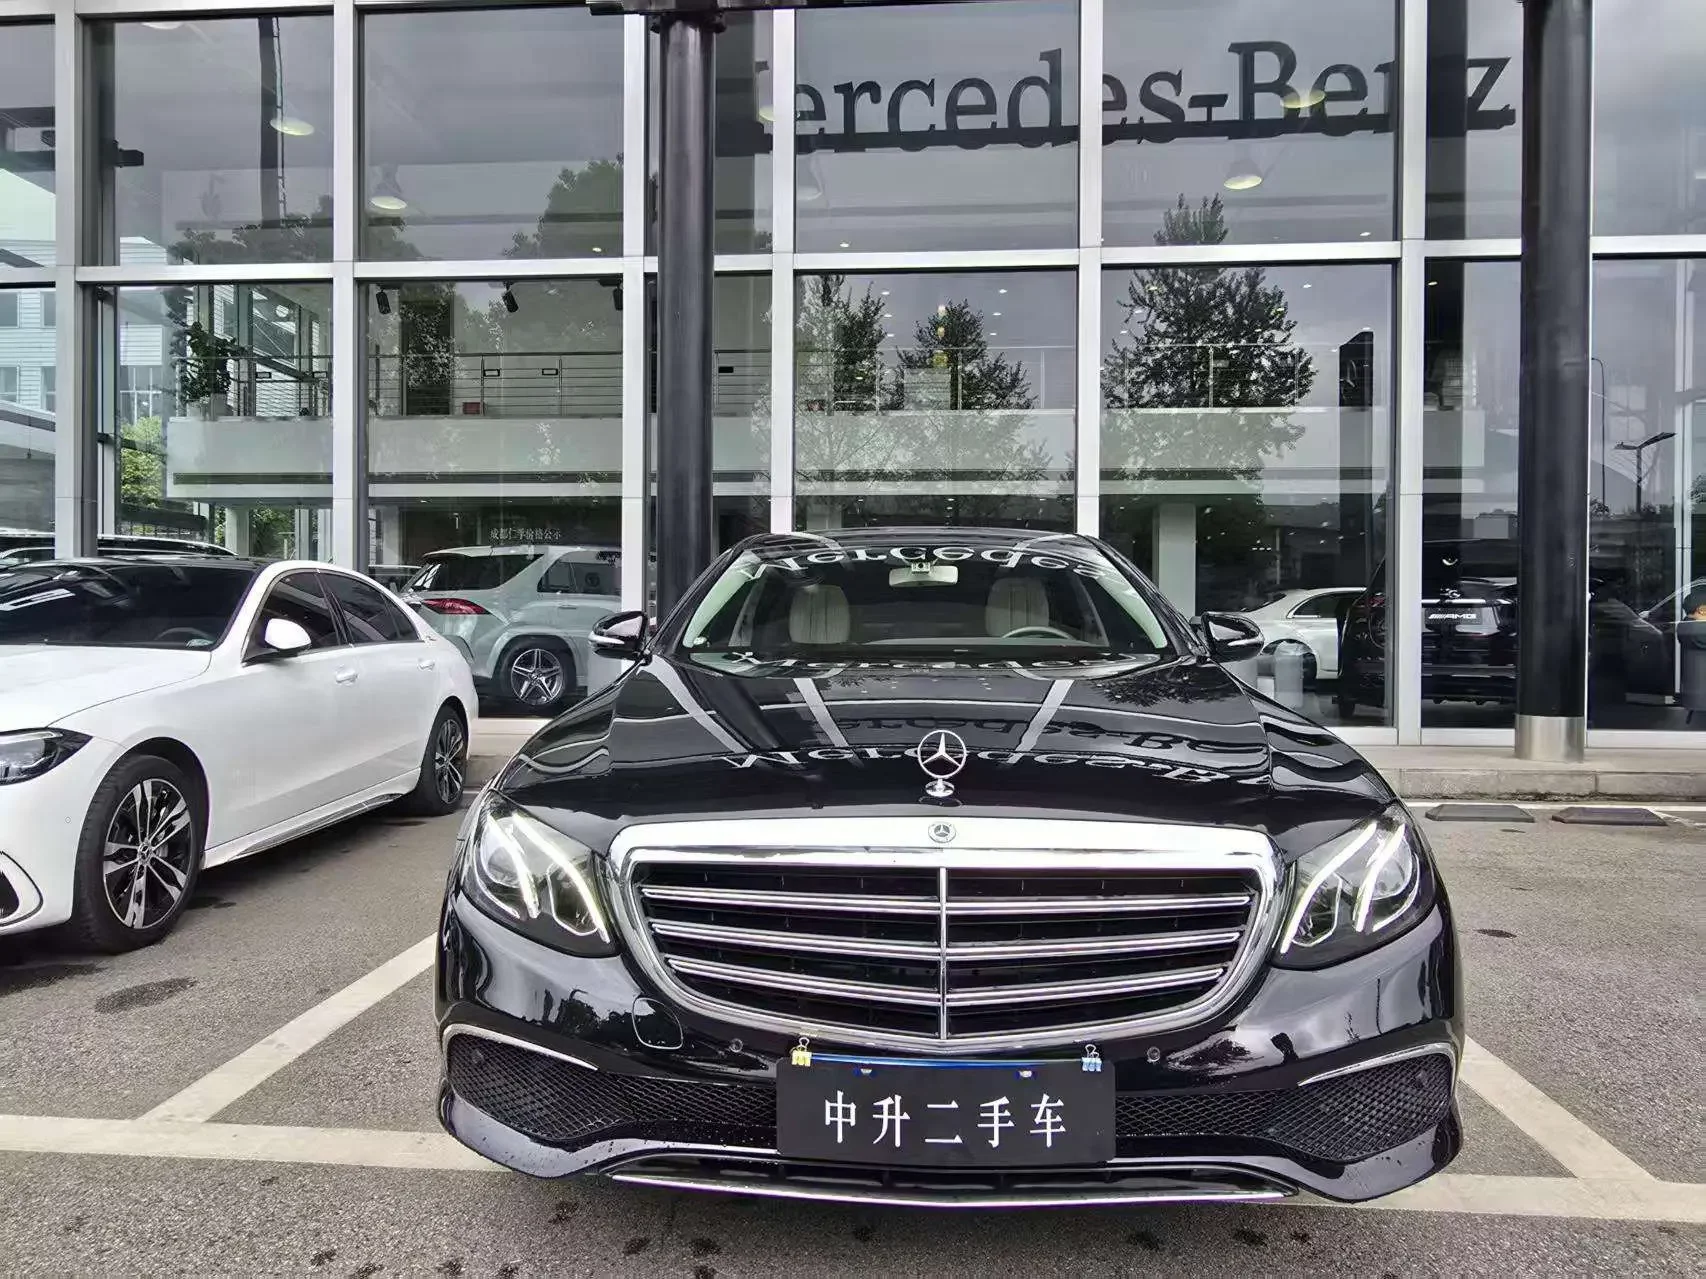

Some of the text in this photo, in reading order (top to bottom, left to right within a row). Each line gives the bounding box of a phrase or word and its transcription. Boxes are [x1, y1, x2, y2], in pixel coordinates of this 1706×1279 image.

[824, 1089, 1067, 1149] 中升二手车
